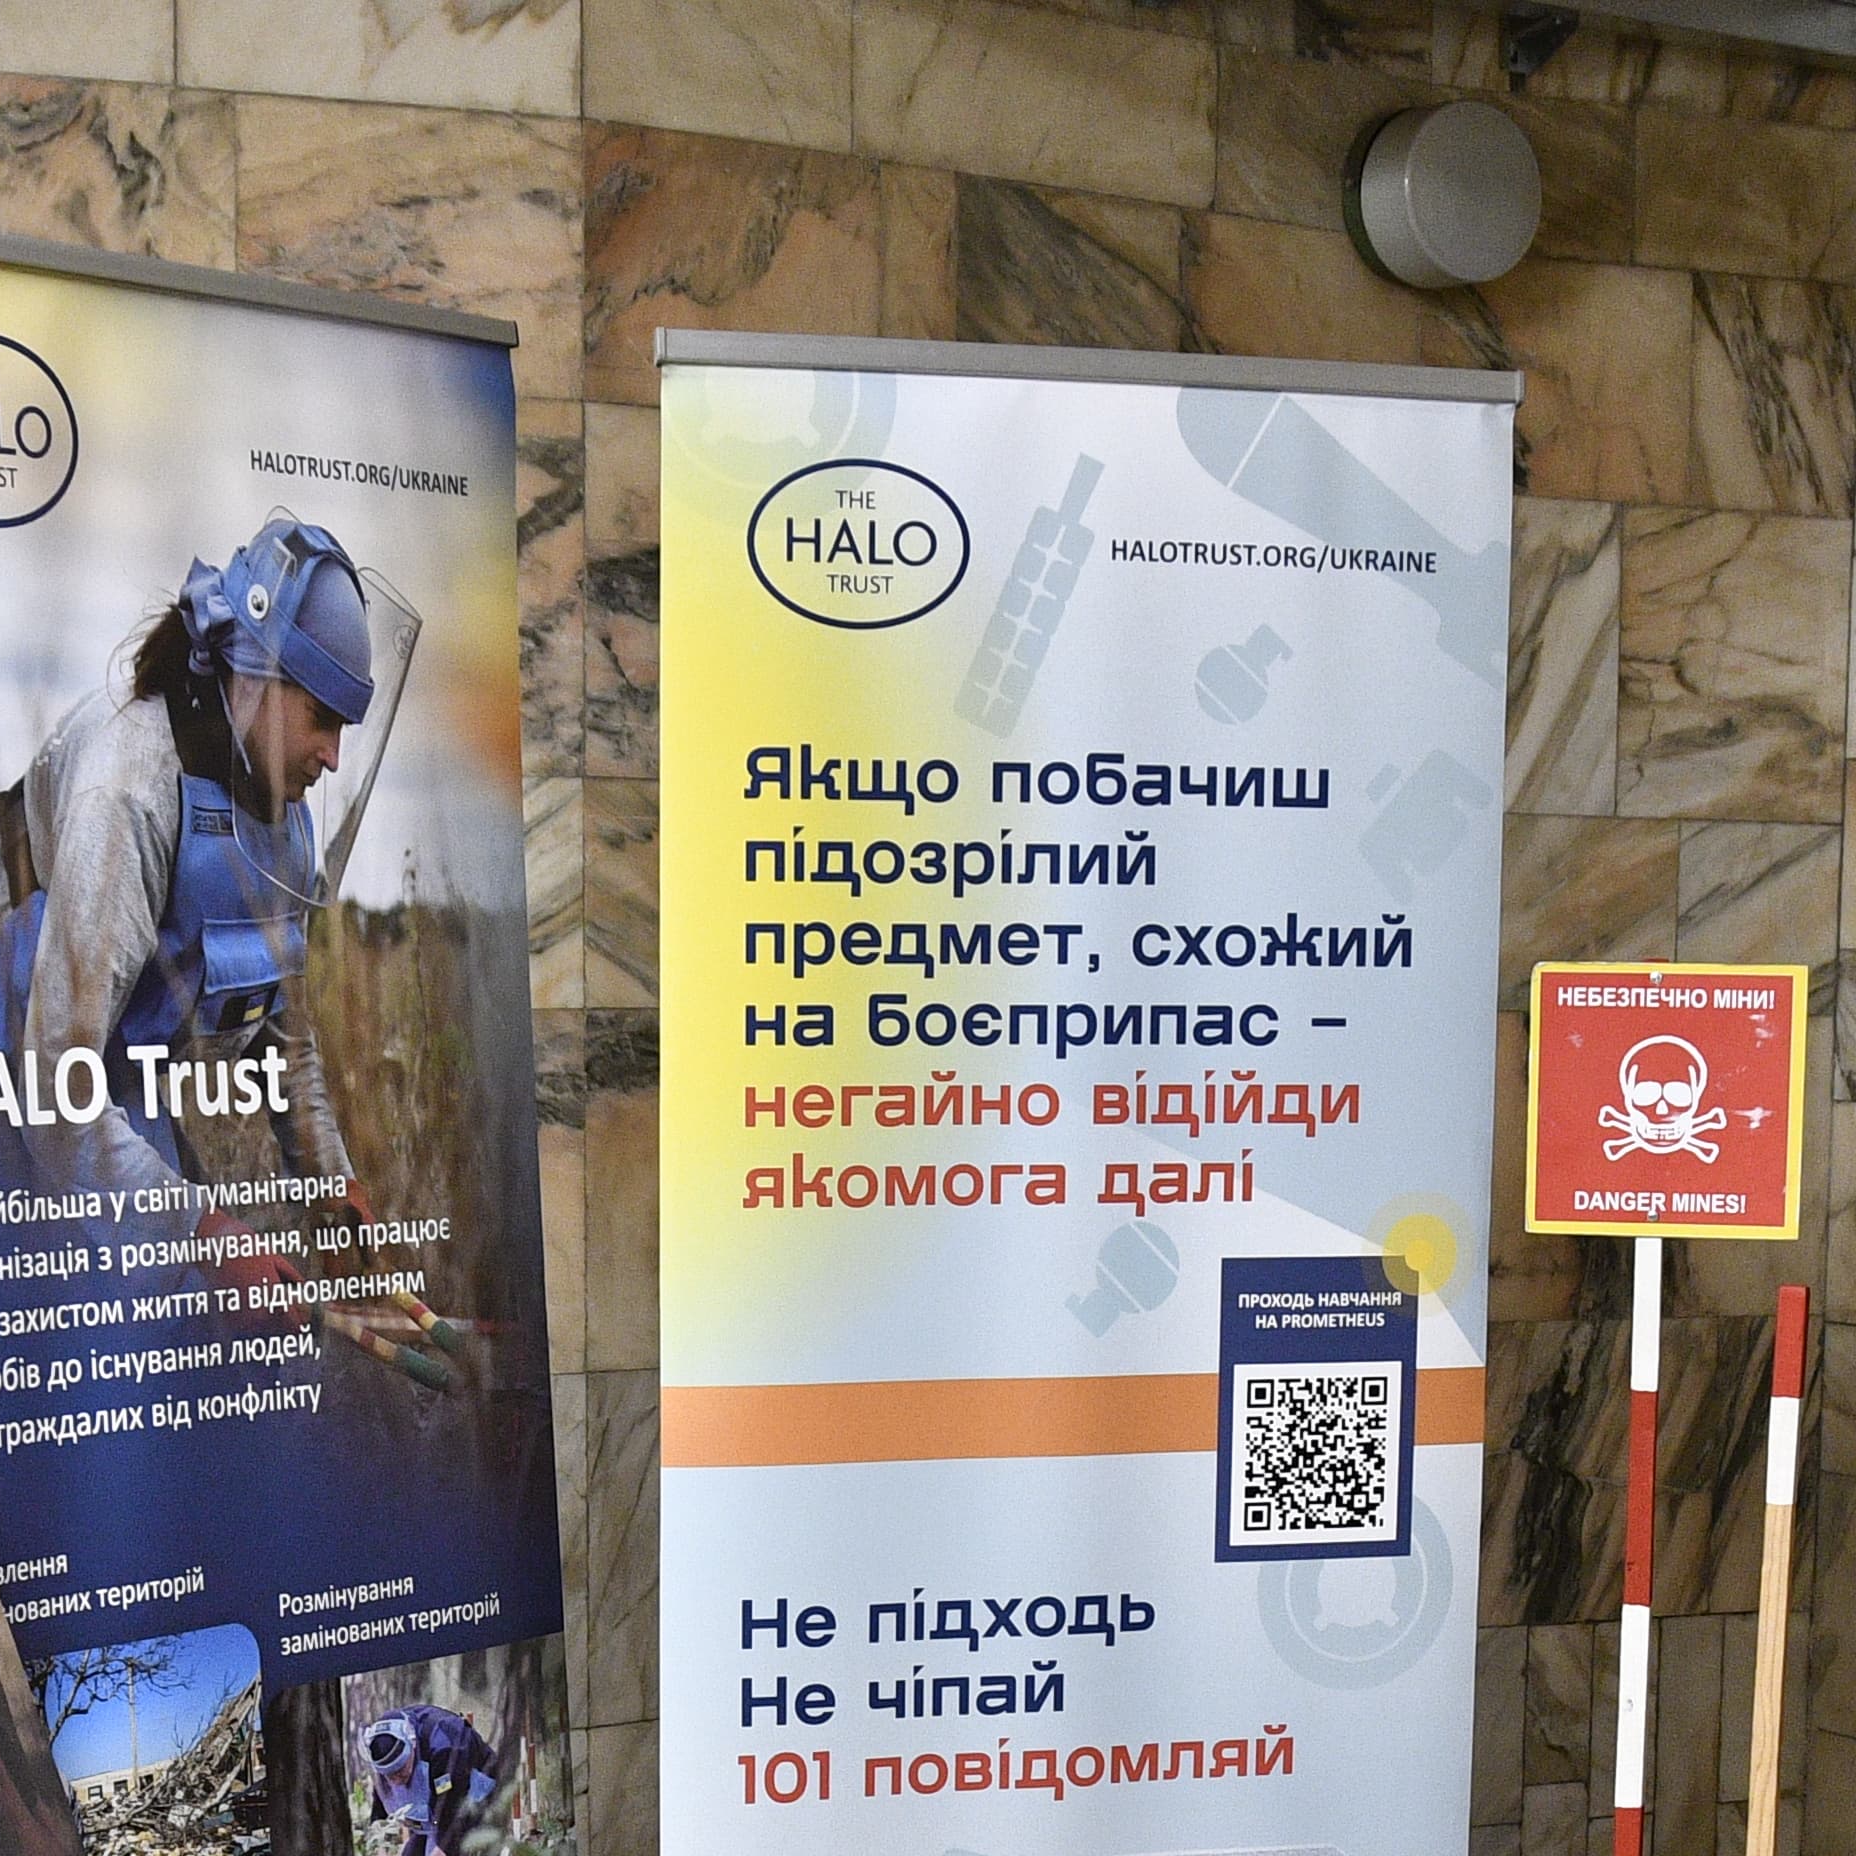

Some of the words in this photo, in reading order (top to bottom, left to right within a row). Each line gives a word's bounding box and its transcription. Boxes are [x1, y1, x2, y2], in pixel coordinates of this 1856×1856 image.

[249, 448, 470, 497] HALOTRUST.ORG/UKRAINE
[834, 489, 877, 511] THE
[784, 518, 938, 567] HALO
[1110, 537, 1439, 575] HALOTRUST.ORG/UKRAINE
[826, 572, 894, 595] TRUST
[744, 743, 960, 816] Якщо
[991, 752, 1330, 810] побачиш
[744, 825, 1158, 898] підозрілий
[744, 917, 1102, 978] предмет,
[1132, 912, 1414, 970] схожий
[744, 1001, 835, 1049] на
[868, 993, 1280, 1059] боєприпас
[1557, 986, 1708, 1010] НЕБЕЗПЕЧНО
[1713, 988, 1776, 1010] МІНИ!
[126, 1043, 289, 1121] Trust
[744, 1070, 1062, 1130] негайно
[1092, 1068, 1361, 1137] відійди
[109, 1191, 127, 1223] у
[133, 1179, 189, 1215] світі
[196, 1171, 348, 1216] гуманітарна
[744, 1153, 1069, 1211] якомога
[1097, 1149, 1255, 1217] далі
[1574, 1190, 1666, 1213] DANGER
[1671, 1193, 1747, 1215] MINES!
[97, 1246, 114, 1272] з
[120, 1231, 309, 1284] розмінування,
[315, 1222, 353, 1255] що
[357, 1215, 452, 1253] працює
[131, 1288, 209, 1327] життя
[214, 1287, 241, 1315] та
[248, 1267, 427, 1311] відновленням
[1238, 1292, 1315, 1313] ПРОХОДЬ
[1318, 1290, 1403, 1310] НАВЧАННЯ
[1254, 1312, 1278, 1331] НА
[1281, 1311, 1386, 1331] PROMETHEUS
[47, 1355, 83, 1389] до
[90, 1340, 224, 1384] існування
[229, 1325, 322, 1366] людей,
[151, 1393, 192, 1430] від
[197, 1380, 323, 1427] конфлікту
[96, 1566, 205, 1611] територій
[277, 1574, 415, 1618] Розмінування
[740, 1599, 837, 1650] Не
[867, 1586, 1156, 1651] підходь
[280, 1611, 406, 1656] замінованих
[408, 1592, 501, 1633] територій
[740, 1677, 837, 1728] Не
[867, 1660, 1066, 1721] чіпай
[738, 1750, 833, 1806] 101
[863, 1724, 1296, 1801] повідомляй
